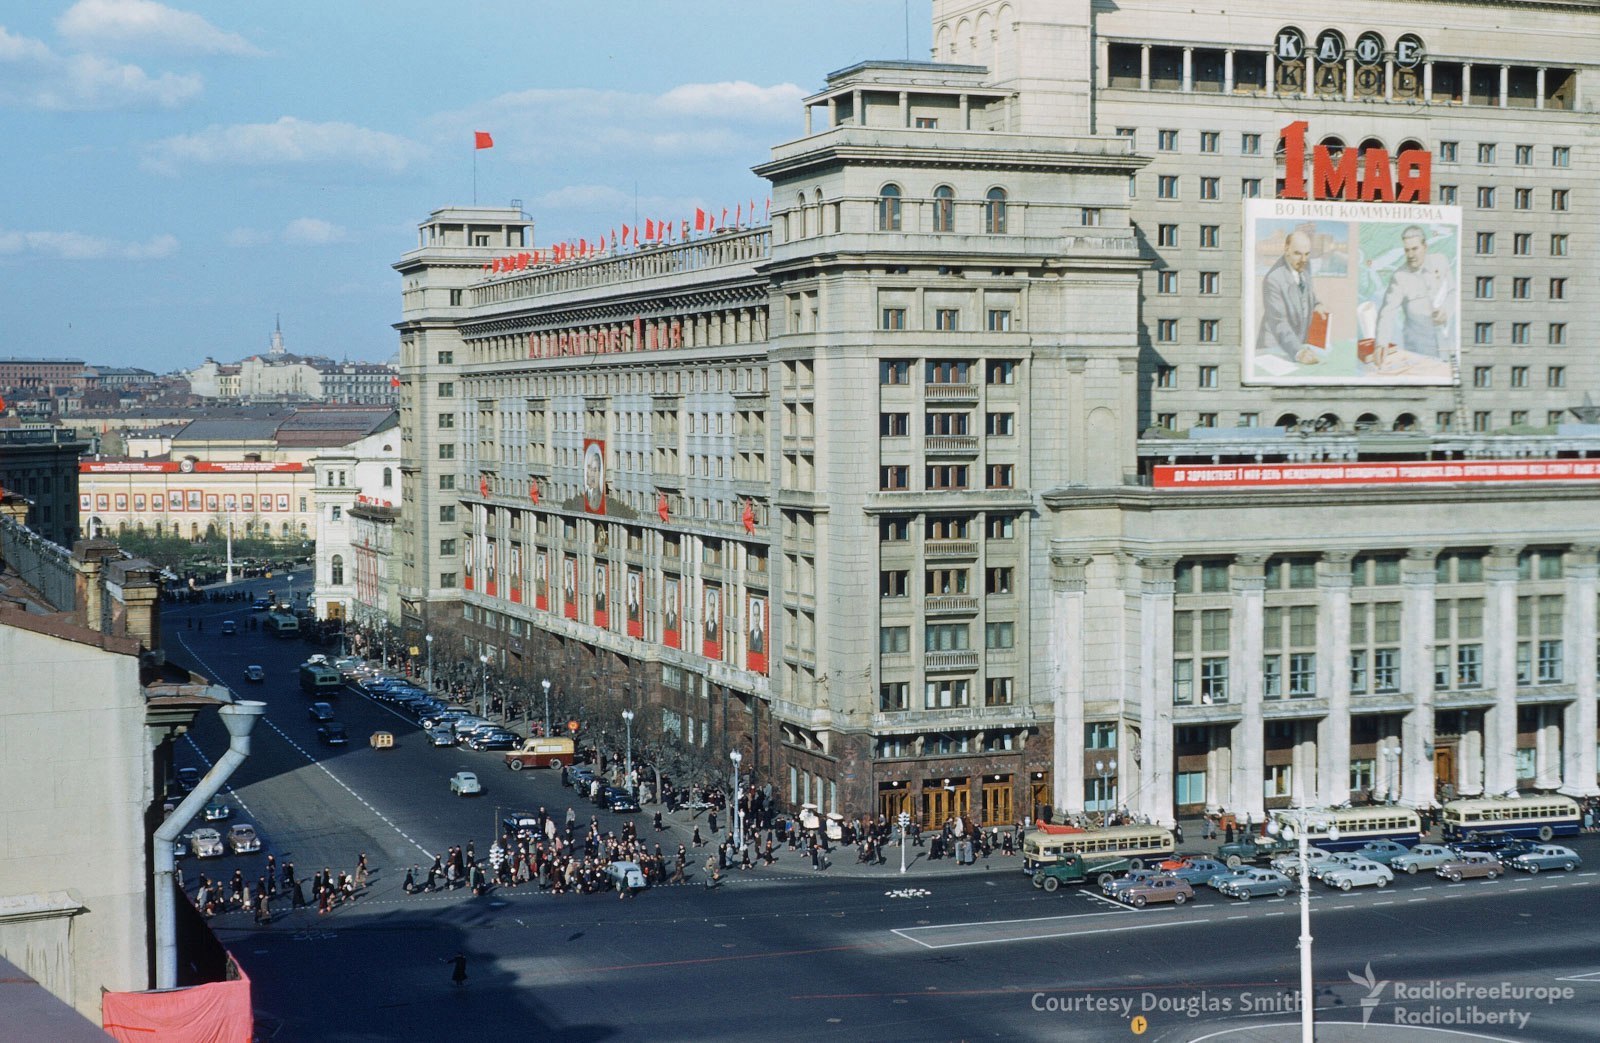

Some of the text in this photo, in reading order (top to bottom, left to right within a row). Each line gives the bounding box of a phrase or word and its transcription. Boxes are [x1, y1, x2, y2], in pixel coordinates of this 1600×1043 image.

[1278, 34, 1420, 63] КАФЕ
[1280, 121, 1432, 203] 1 МАЯ
[1275, 203, 1443, 220] ВО ИМЯ КОММУНИЗМА
